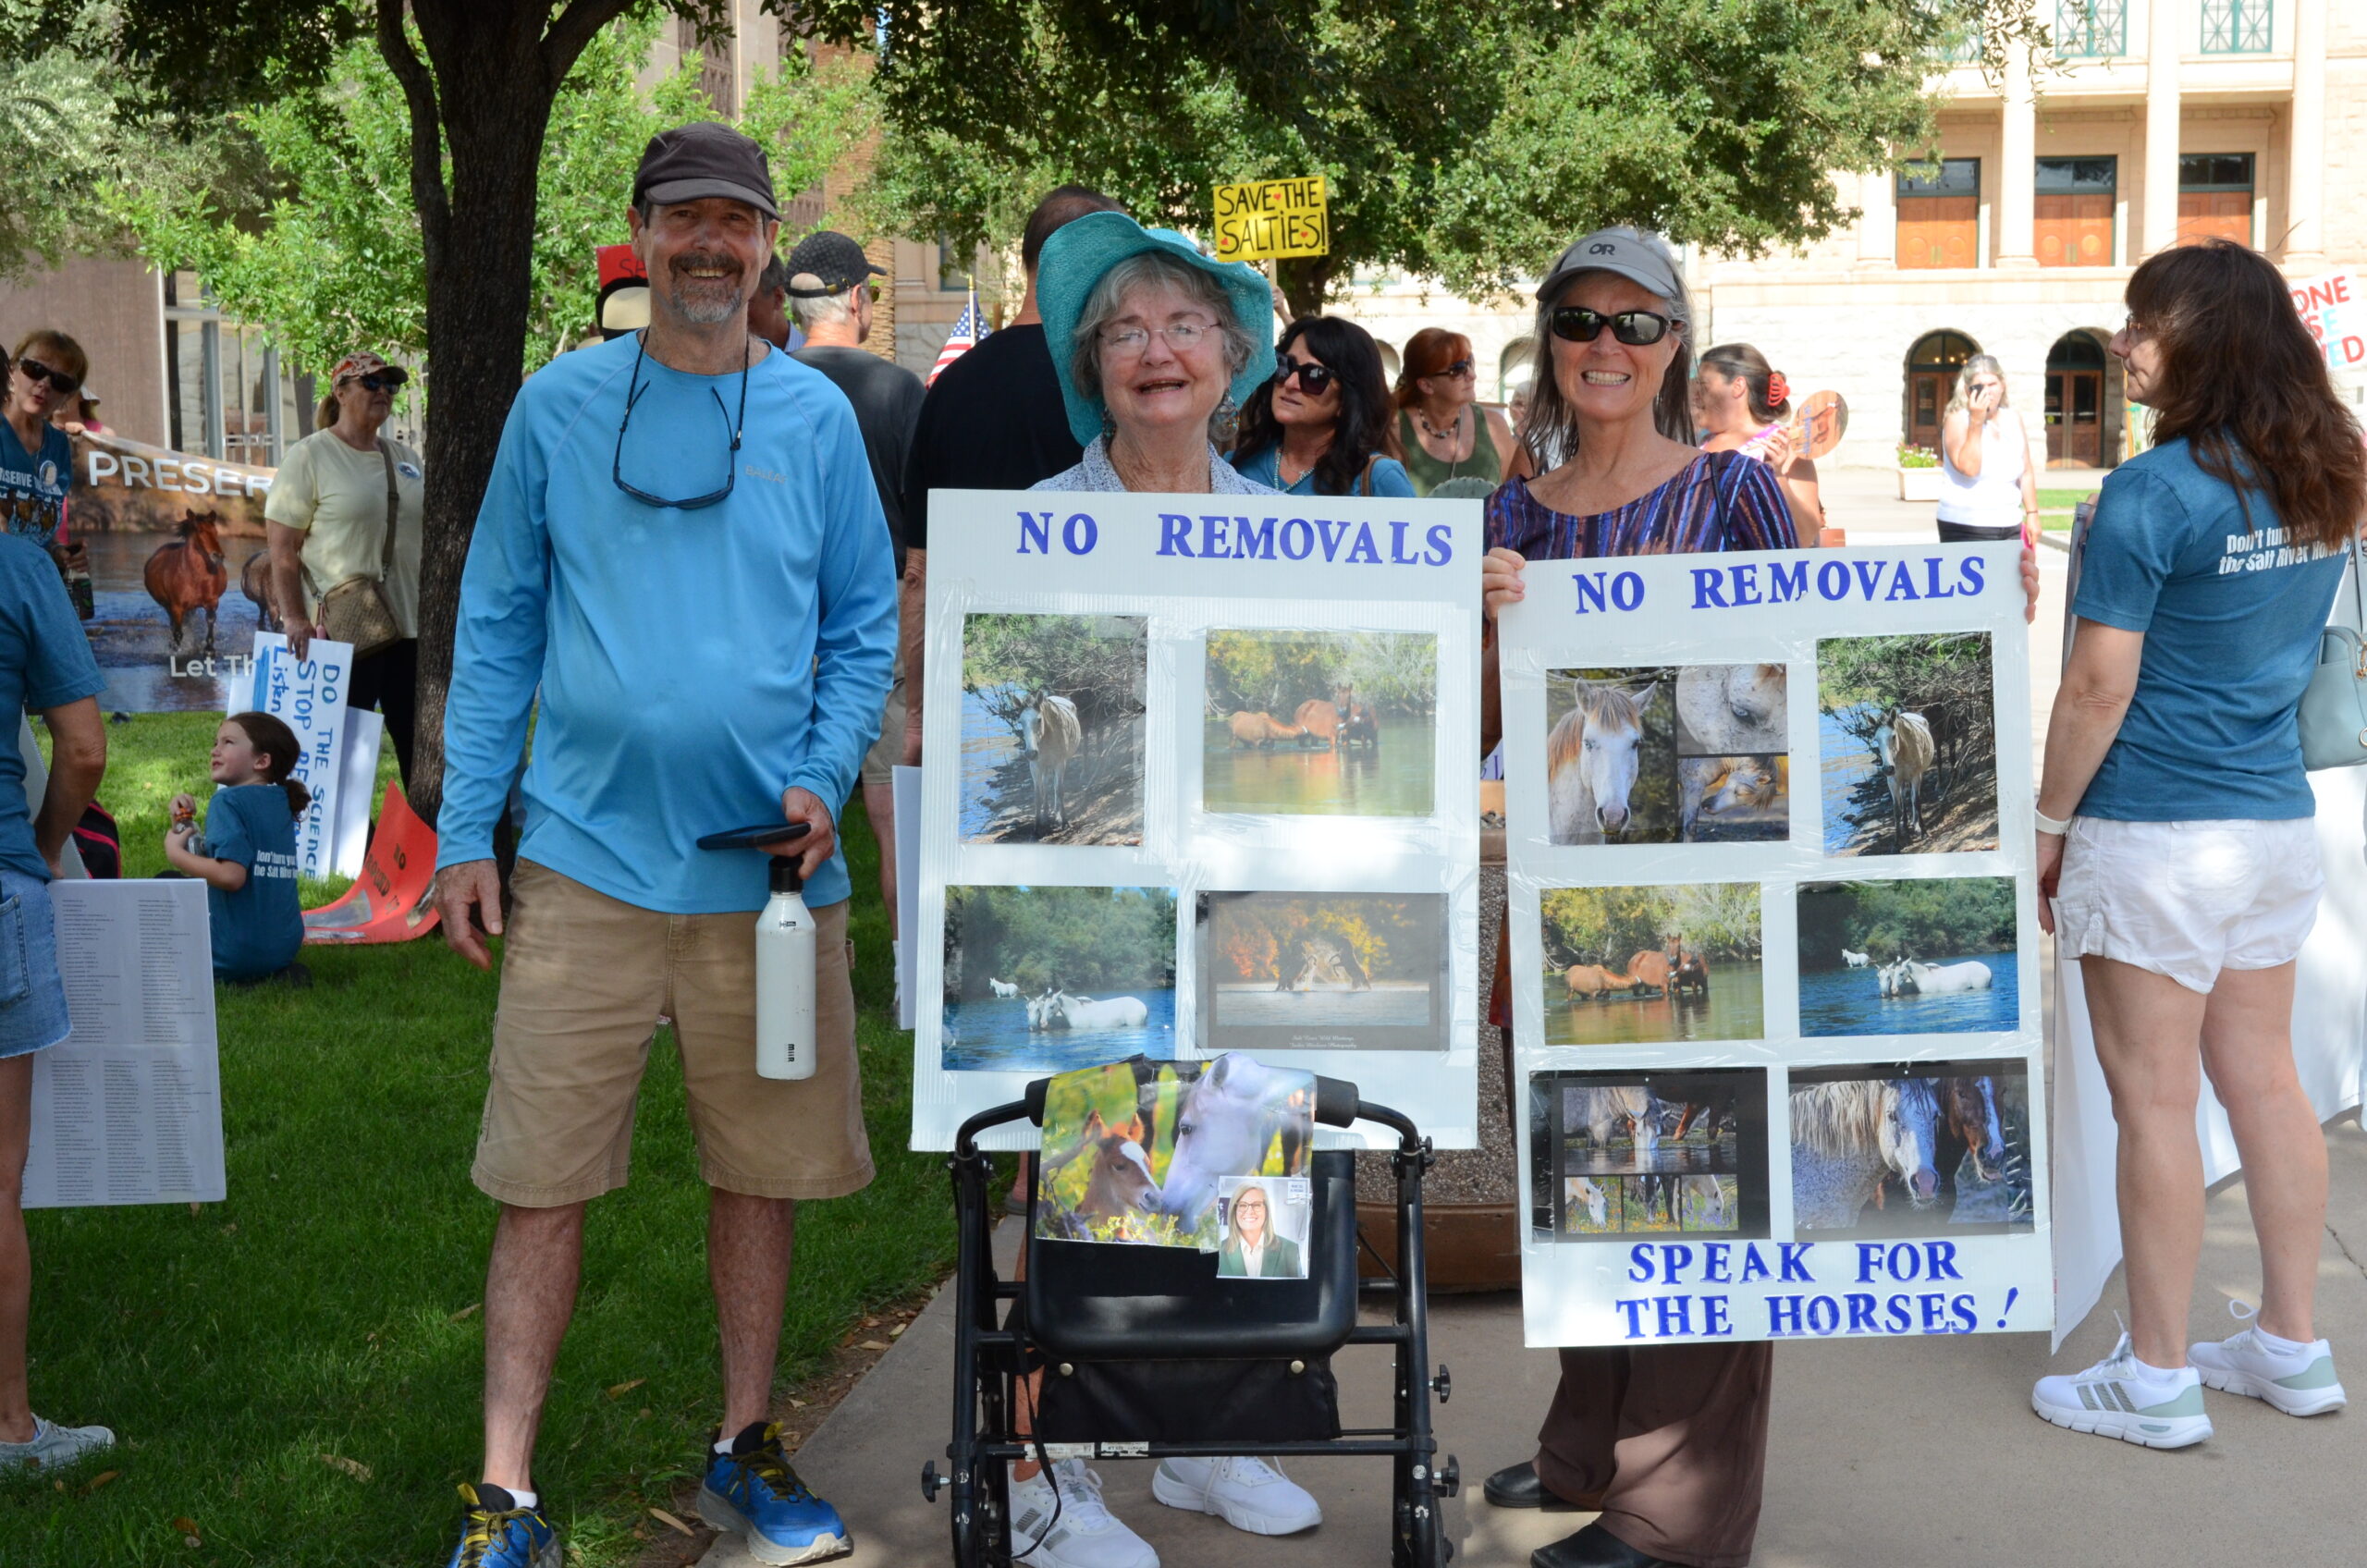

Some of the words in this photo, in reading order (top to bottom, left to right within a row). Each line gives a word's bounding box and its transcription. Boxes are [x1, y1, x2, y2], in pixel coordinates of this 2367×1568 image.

[1219, 183, 1276, 216] SAVE
[1280, 179, 1320, 209] THE
[1588, 243, 1615, 256] OR
[88, 450, 274, 497] PRESER
[1017, 511, 1098, 555] NO
[1156, 513, 1453, 567] REMOVALS
[2218, 556, 2245, 575] the
[2275, 545, 2310, 568] River
[2226, 529, 2263, 555] Don't
[1572, 570, 1645, 615] NO
[1690, 557, 1985, 609] REMOVALS
[170, 655, 217, 678] Let
[223, 654, 254, 677] Th
[271, 645, 295, 713] Listen
[322, 664, 340, 704] DO
[293, 659, 317, 730] STOP
[314, 728, 333, 769] THE
[1628, 1242, 1817, 1285] SPEAK
[1855, 1241, 1963, 1284] FOR
[1616, 1294, 1734, 1340] THE
